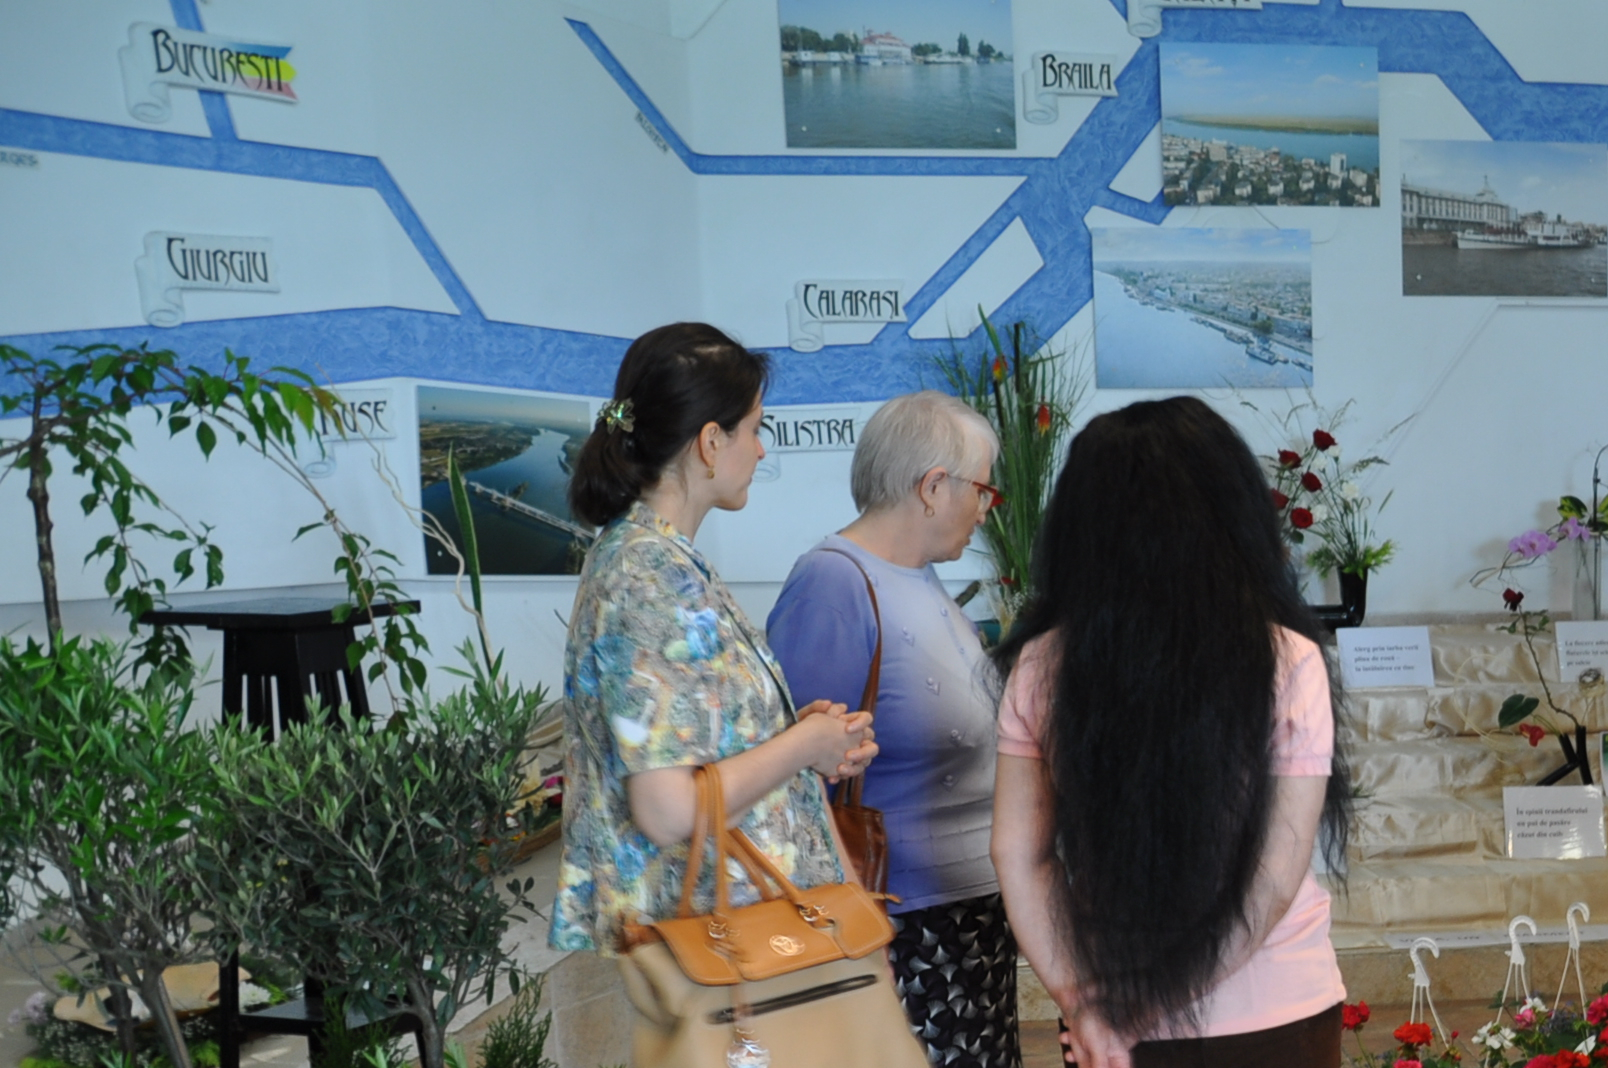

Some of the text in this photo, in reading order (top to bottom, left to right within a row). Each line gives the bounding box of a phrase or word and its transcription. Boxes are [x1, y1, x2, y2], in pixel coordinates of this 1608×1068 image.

[150, 28, 284, 92] BUCURESTI
[1040, 53, 1112, 92] BRAILA
[166, 237, 270, 286] GIURGIU
[760, 414, 856, 449] SILISTRA
